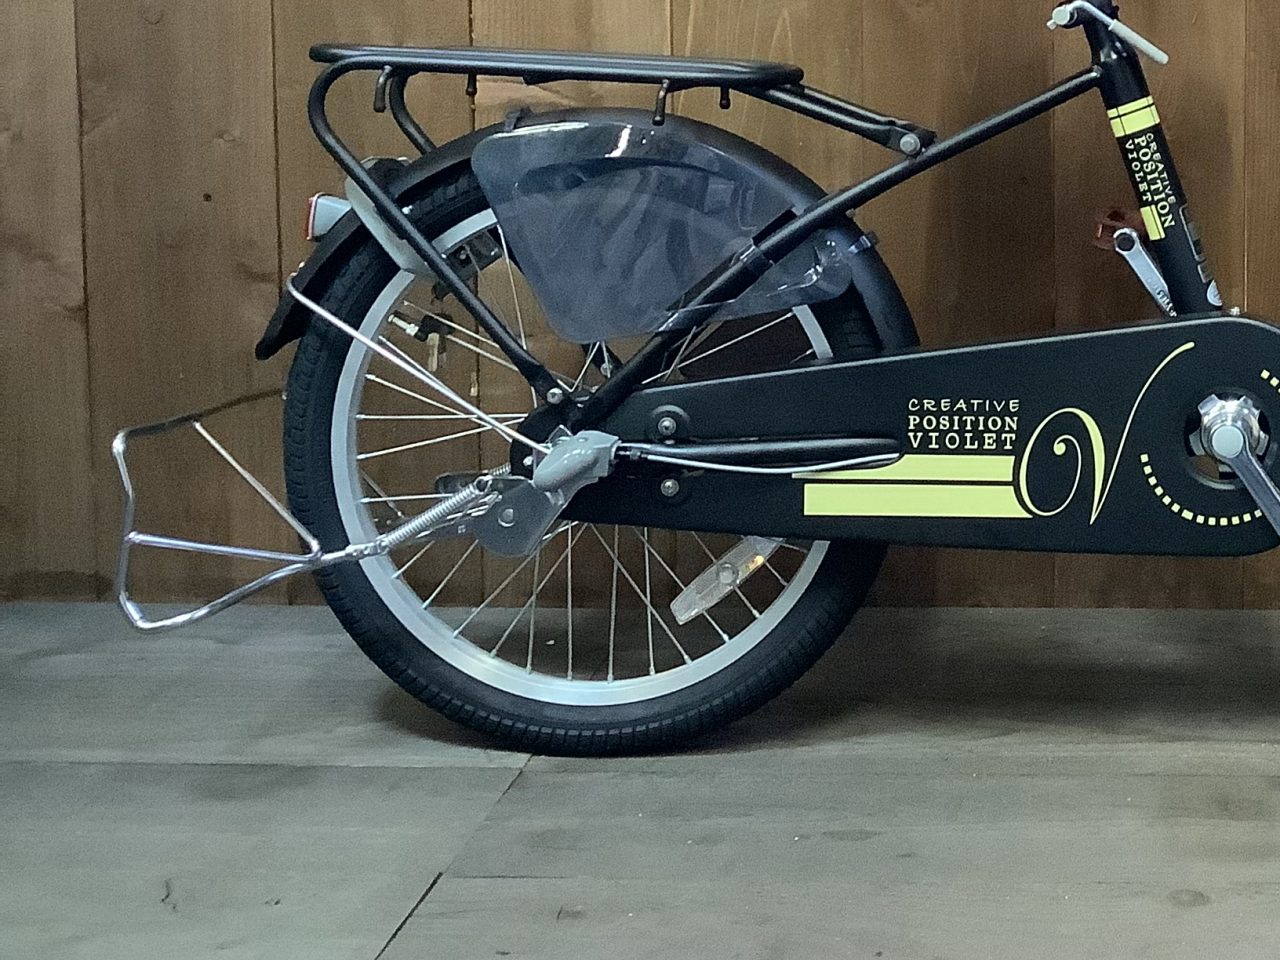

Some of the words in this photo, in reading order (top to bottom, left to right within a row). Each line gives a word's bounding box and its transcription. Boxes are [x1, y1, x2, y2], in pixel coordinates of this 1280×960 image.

[1125, 140, 1152, 202] VIOLET
[1134, 135, 1176, 228] POSITION
[1146, 133, 1177, 203] CREATIVE
[908, 398, 1020, 412] CREATIVE
[908, 415, 1018, 431] POSITION
[908, 433, 1016, 450] VIOLET
